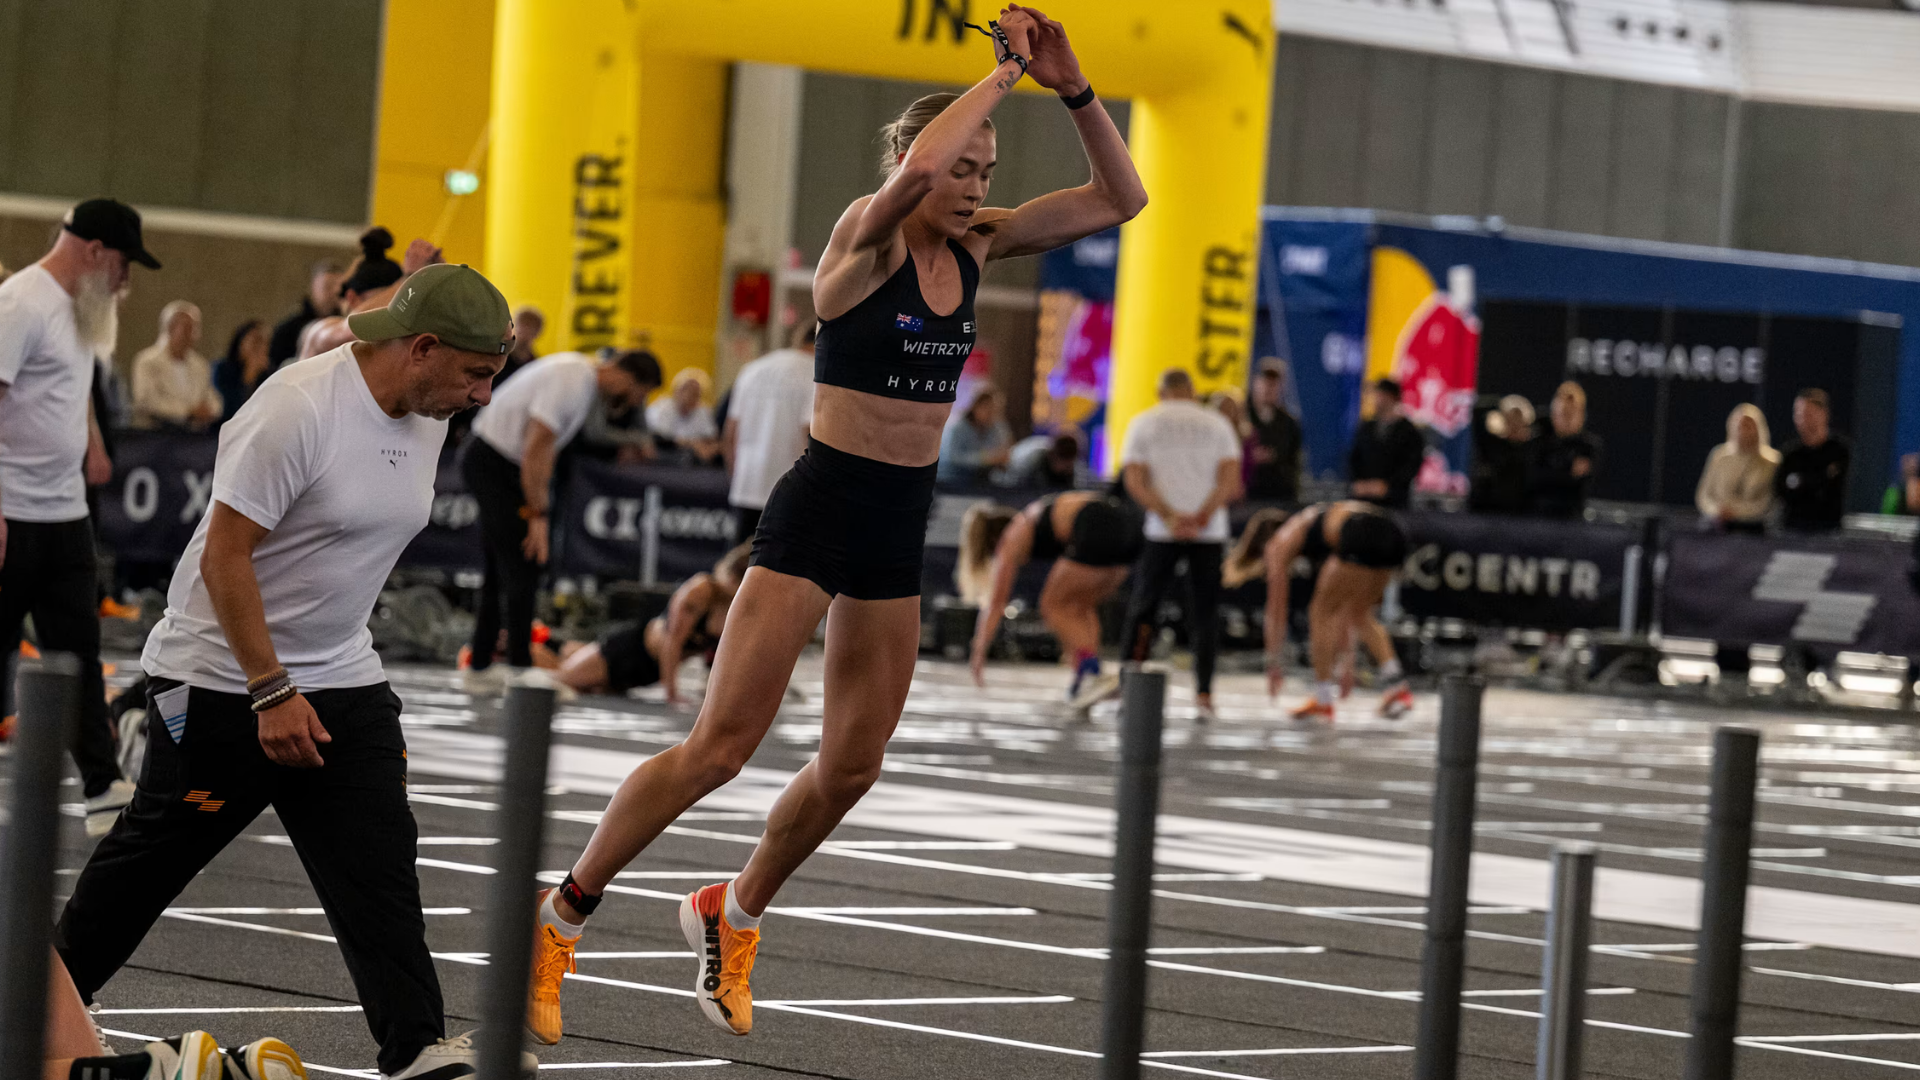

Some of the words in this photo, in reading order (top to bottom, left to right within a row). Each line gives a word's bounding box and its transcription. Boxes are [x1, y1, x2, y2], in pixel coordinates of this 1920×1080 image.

[903, 340, 972, 355] WIETRZYK
[1567, 337, 1765, 384] RECHARGE
[887, 375, 957, 392] HYROX
[381, 449, 407, 457] HYROX
[1443, 551, 1600, 600] CENTR
[704, 909, 721, 991] NITRO
